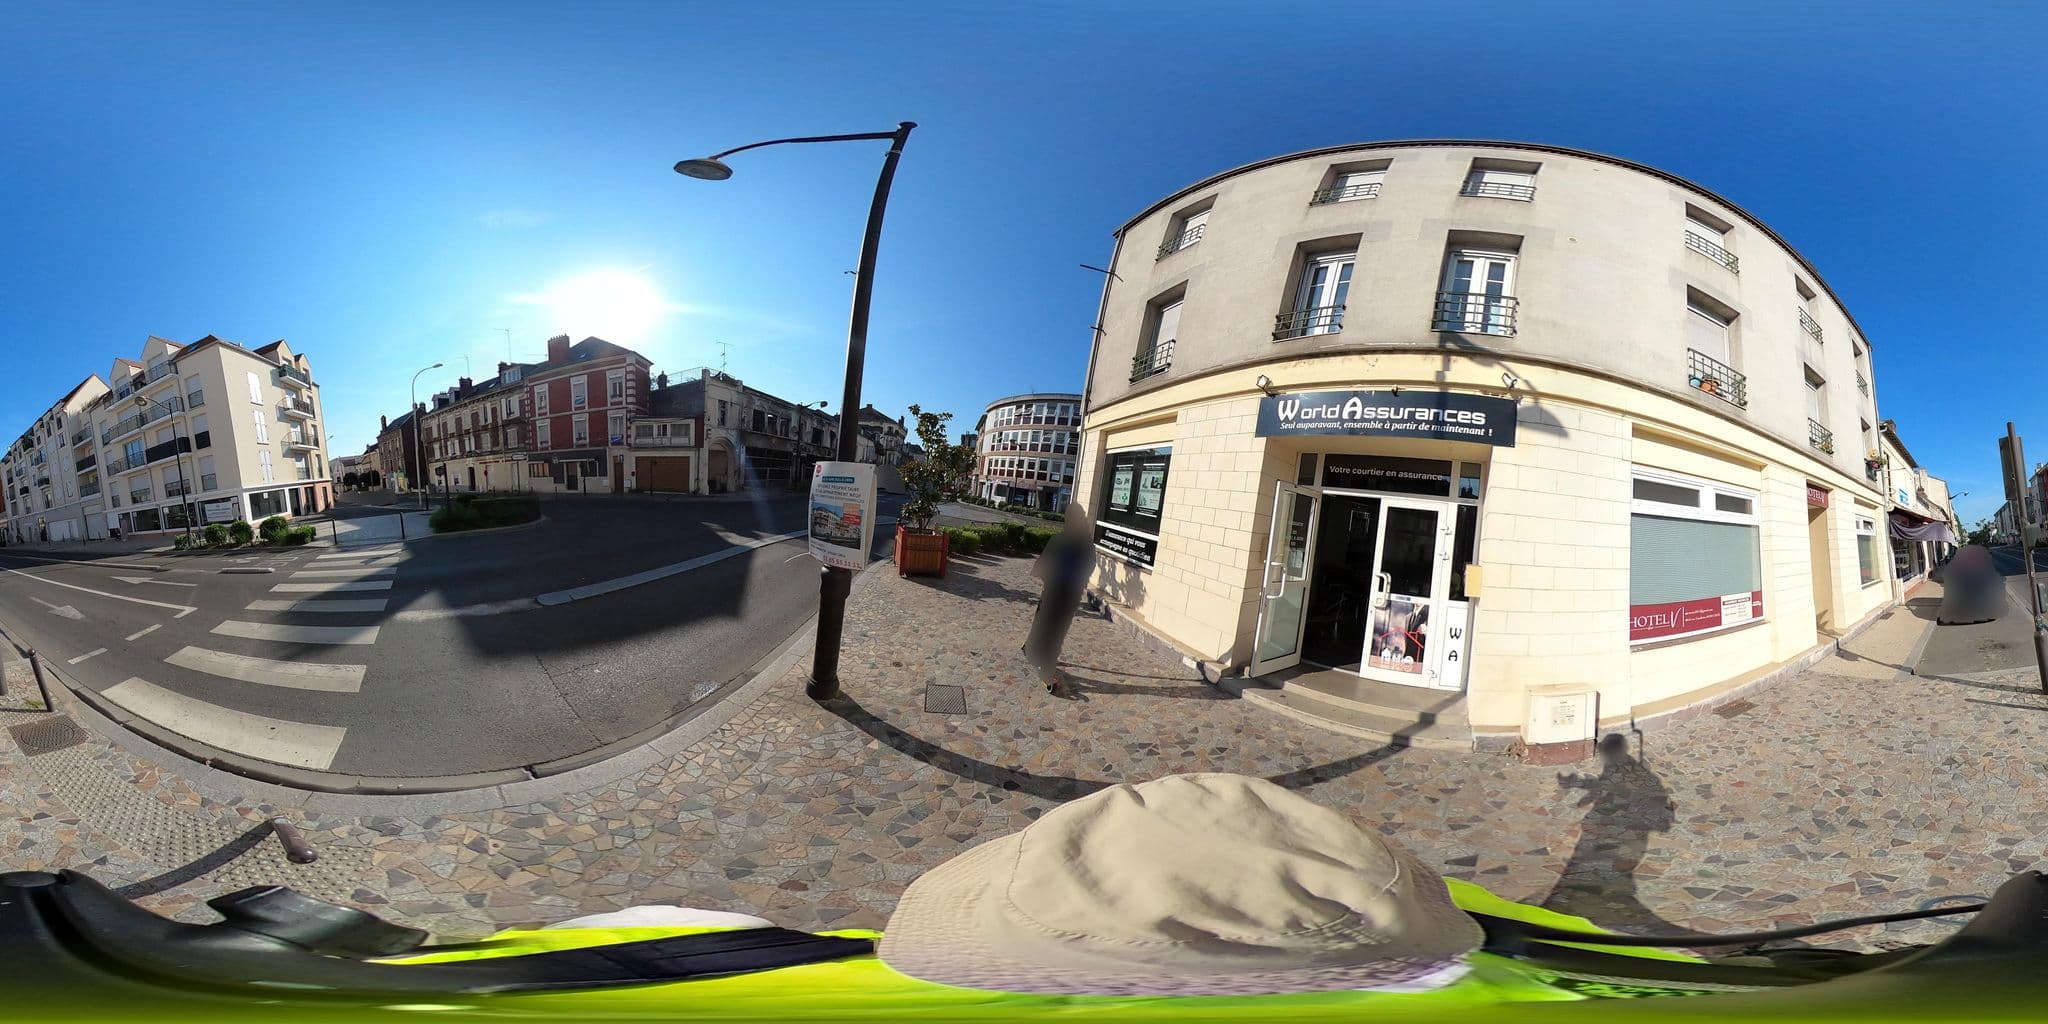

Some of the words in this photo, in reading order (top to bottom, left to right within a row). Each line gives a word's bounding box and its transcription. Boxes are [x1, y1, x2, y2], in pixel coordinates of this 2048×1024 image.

[1278, 399, 1340, 421] World
[1342, 396, 1486, 425] Assurances
[1280, 421, 1296, 430] Seul
[1296, 421, 1342, 430] auparavant,
[1343, 420, 1383, 429] ensemble
[1384, 420, 1390, 429] à
[1391, 422, 1417, 431] partir
[1418, 422, 1431, 431] de
[1431, 424, 1485, 436] maintenant
[1488, 429, 1493, 437] !
[1352, 467, 1384, 476] courtier
[1398, 471, 1444, 480] assurance
